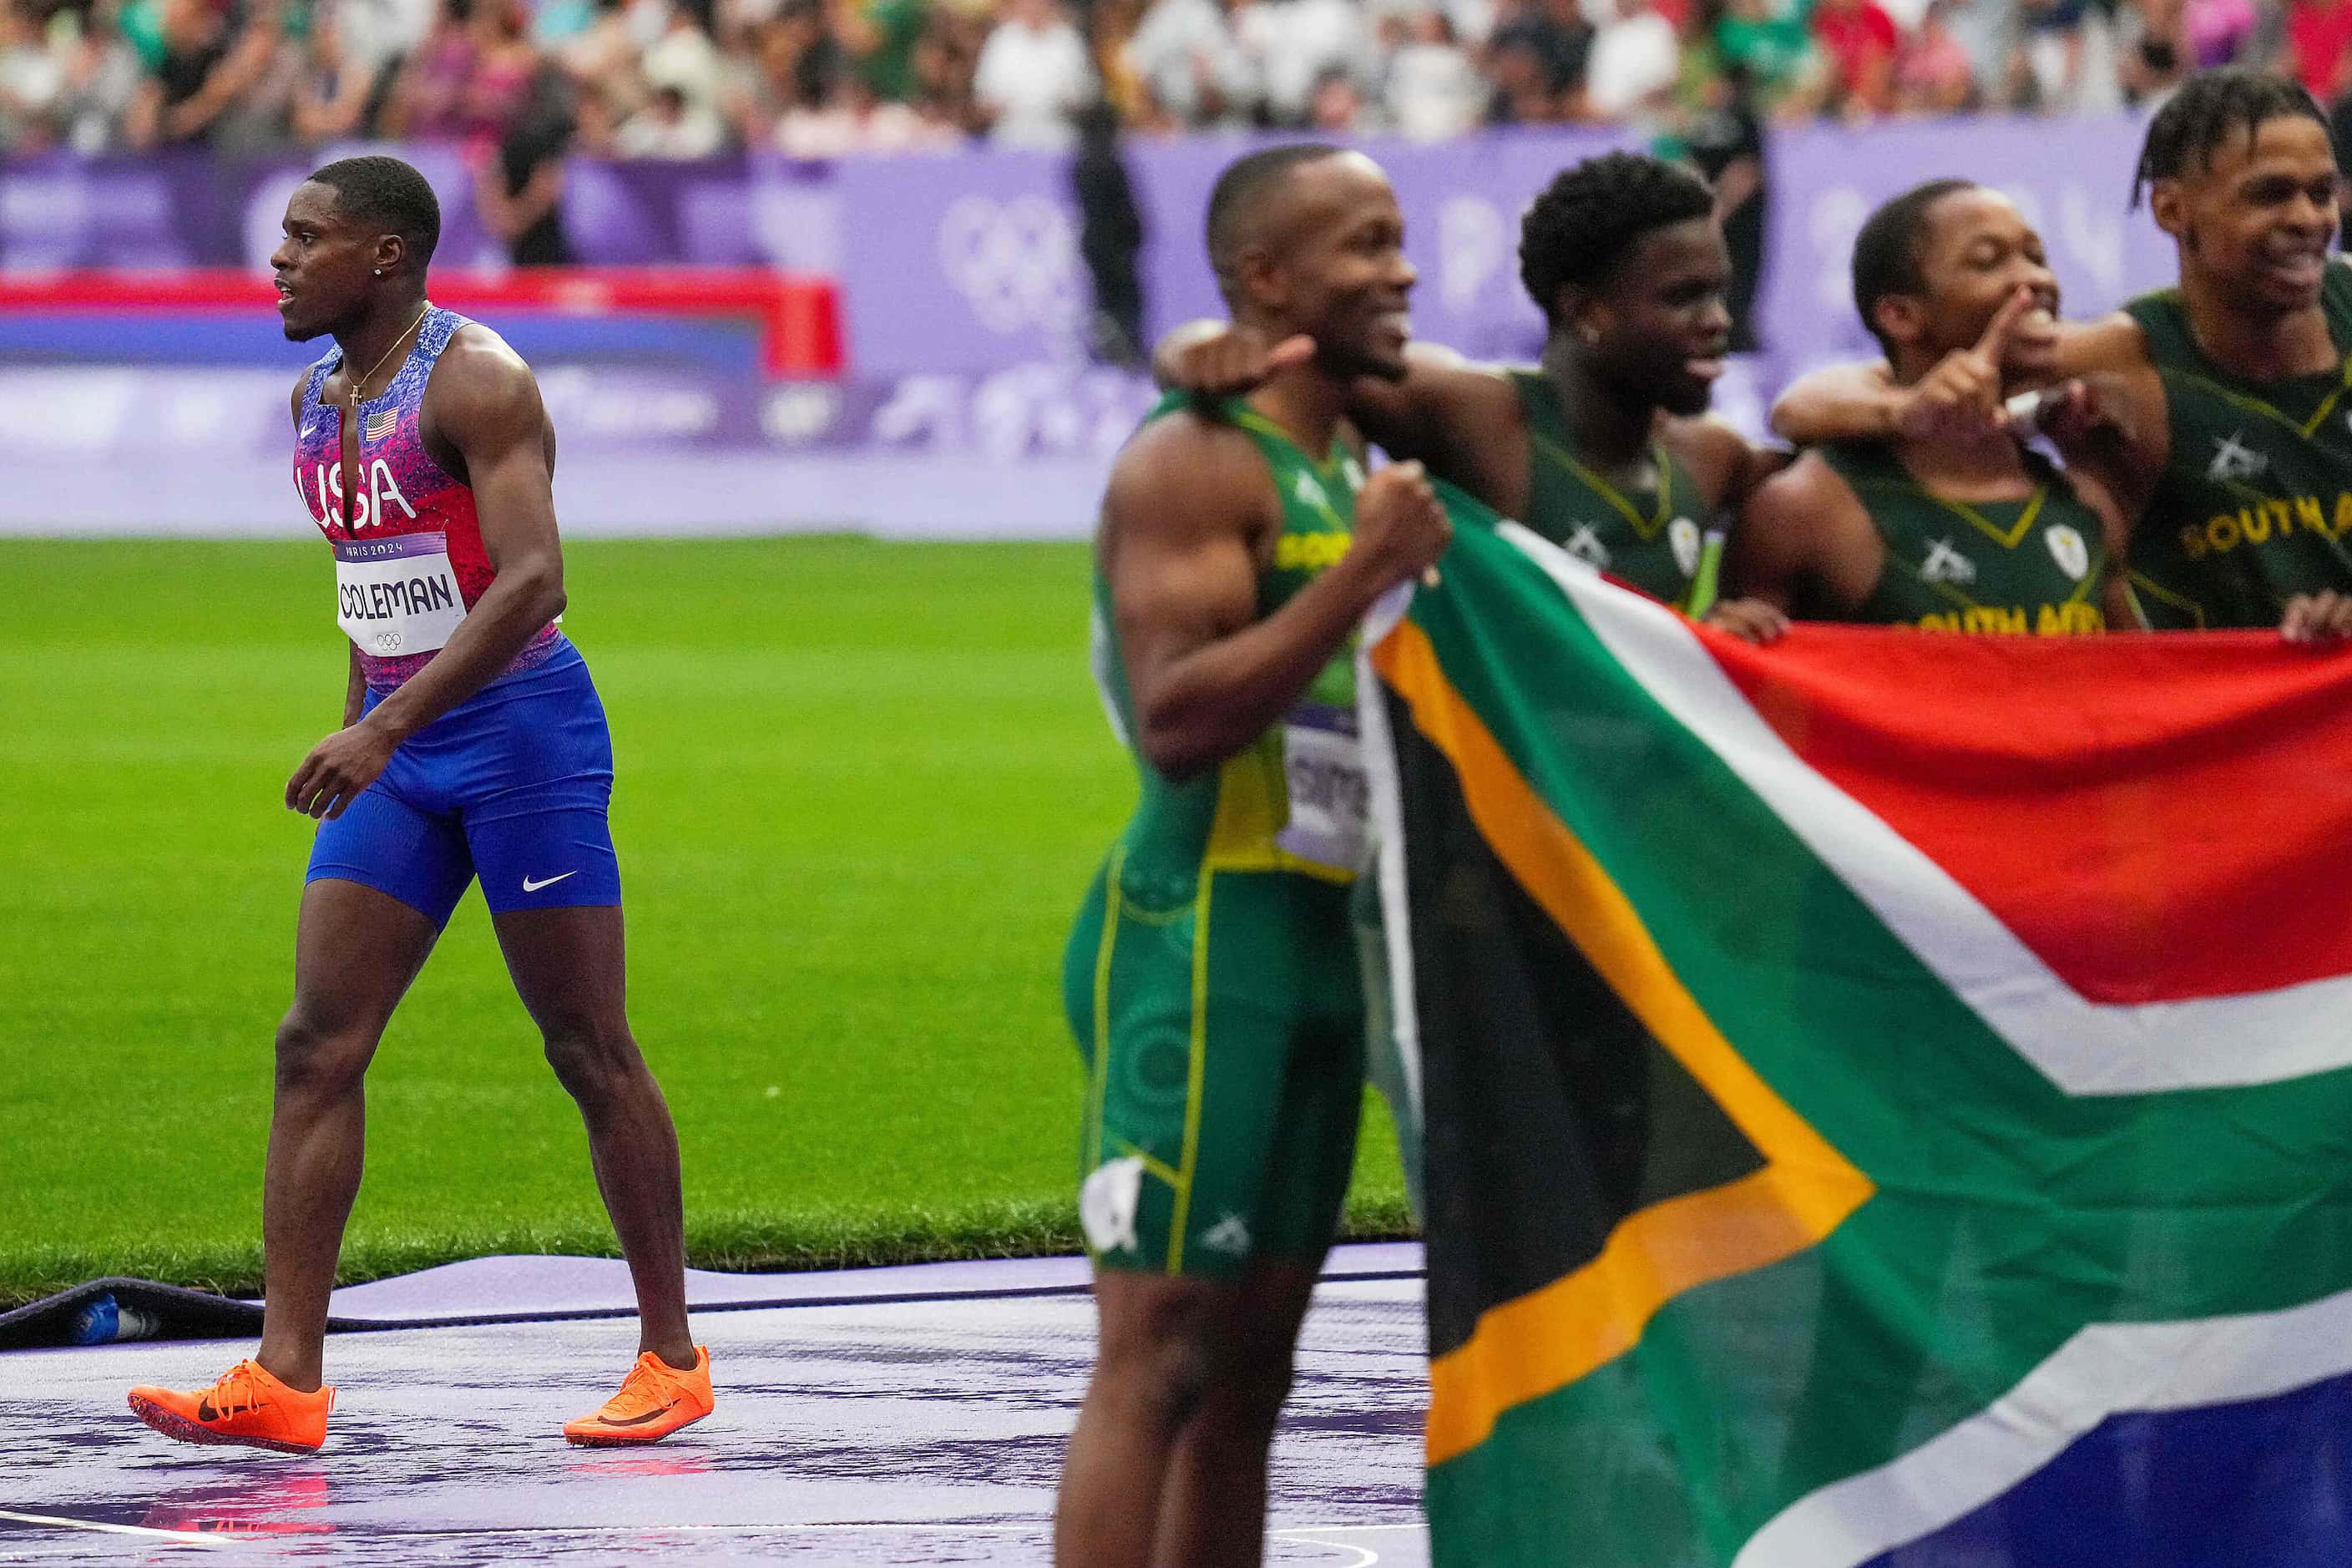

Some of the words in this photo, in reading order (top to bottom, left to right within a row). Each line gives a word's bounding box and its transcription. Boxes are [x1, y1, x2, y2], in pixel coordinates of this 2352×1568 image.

[297, 459, 416, 529] USA
[371, 543, 402, 555] 2024
[340, 574, 453, 620] COLEMAN
